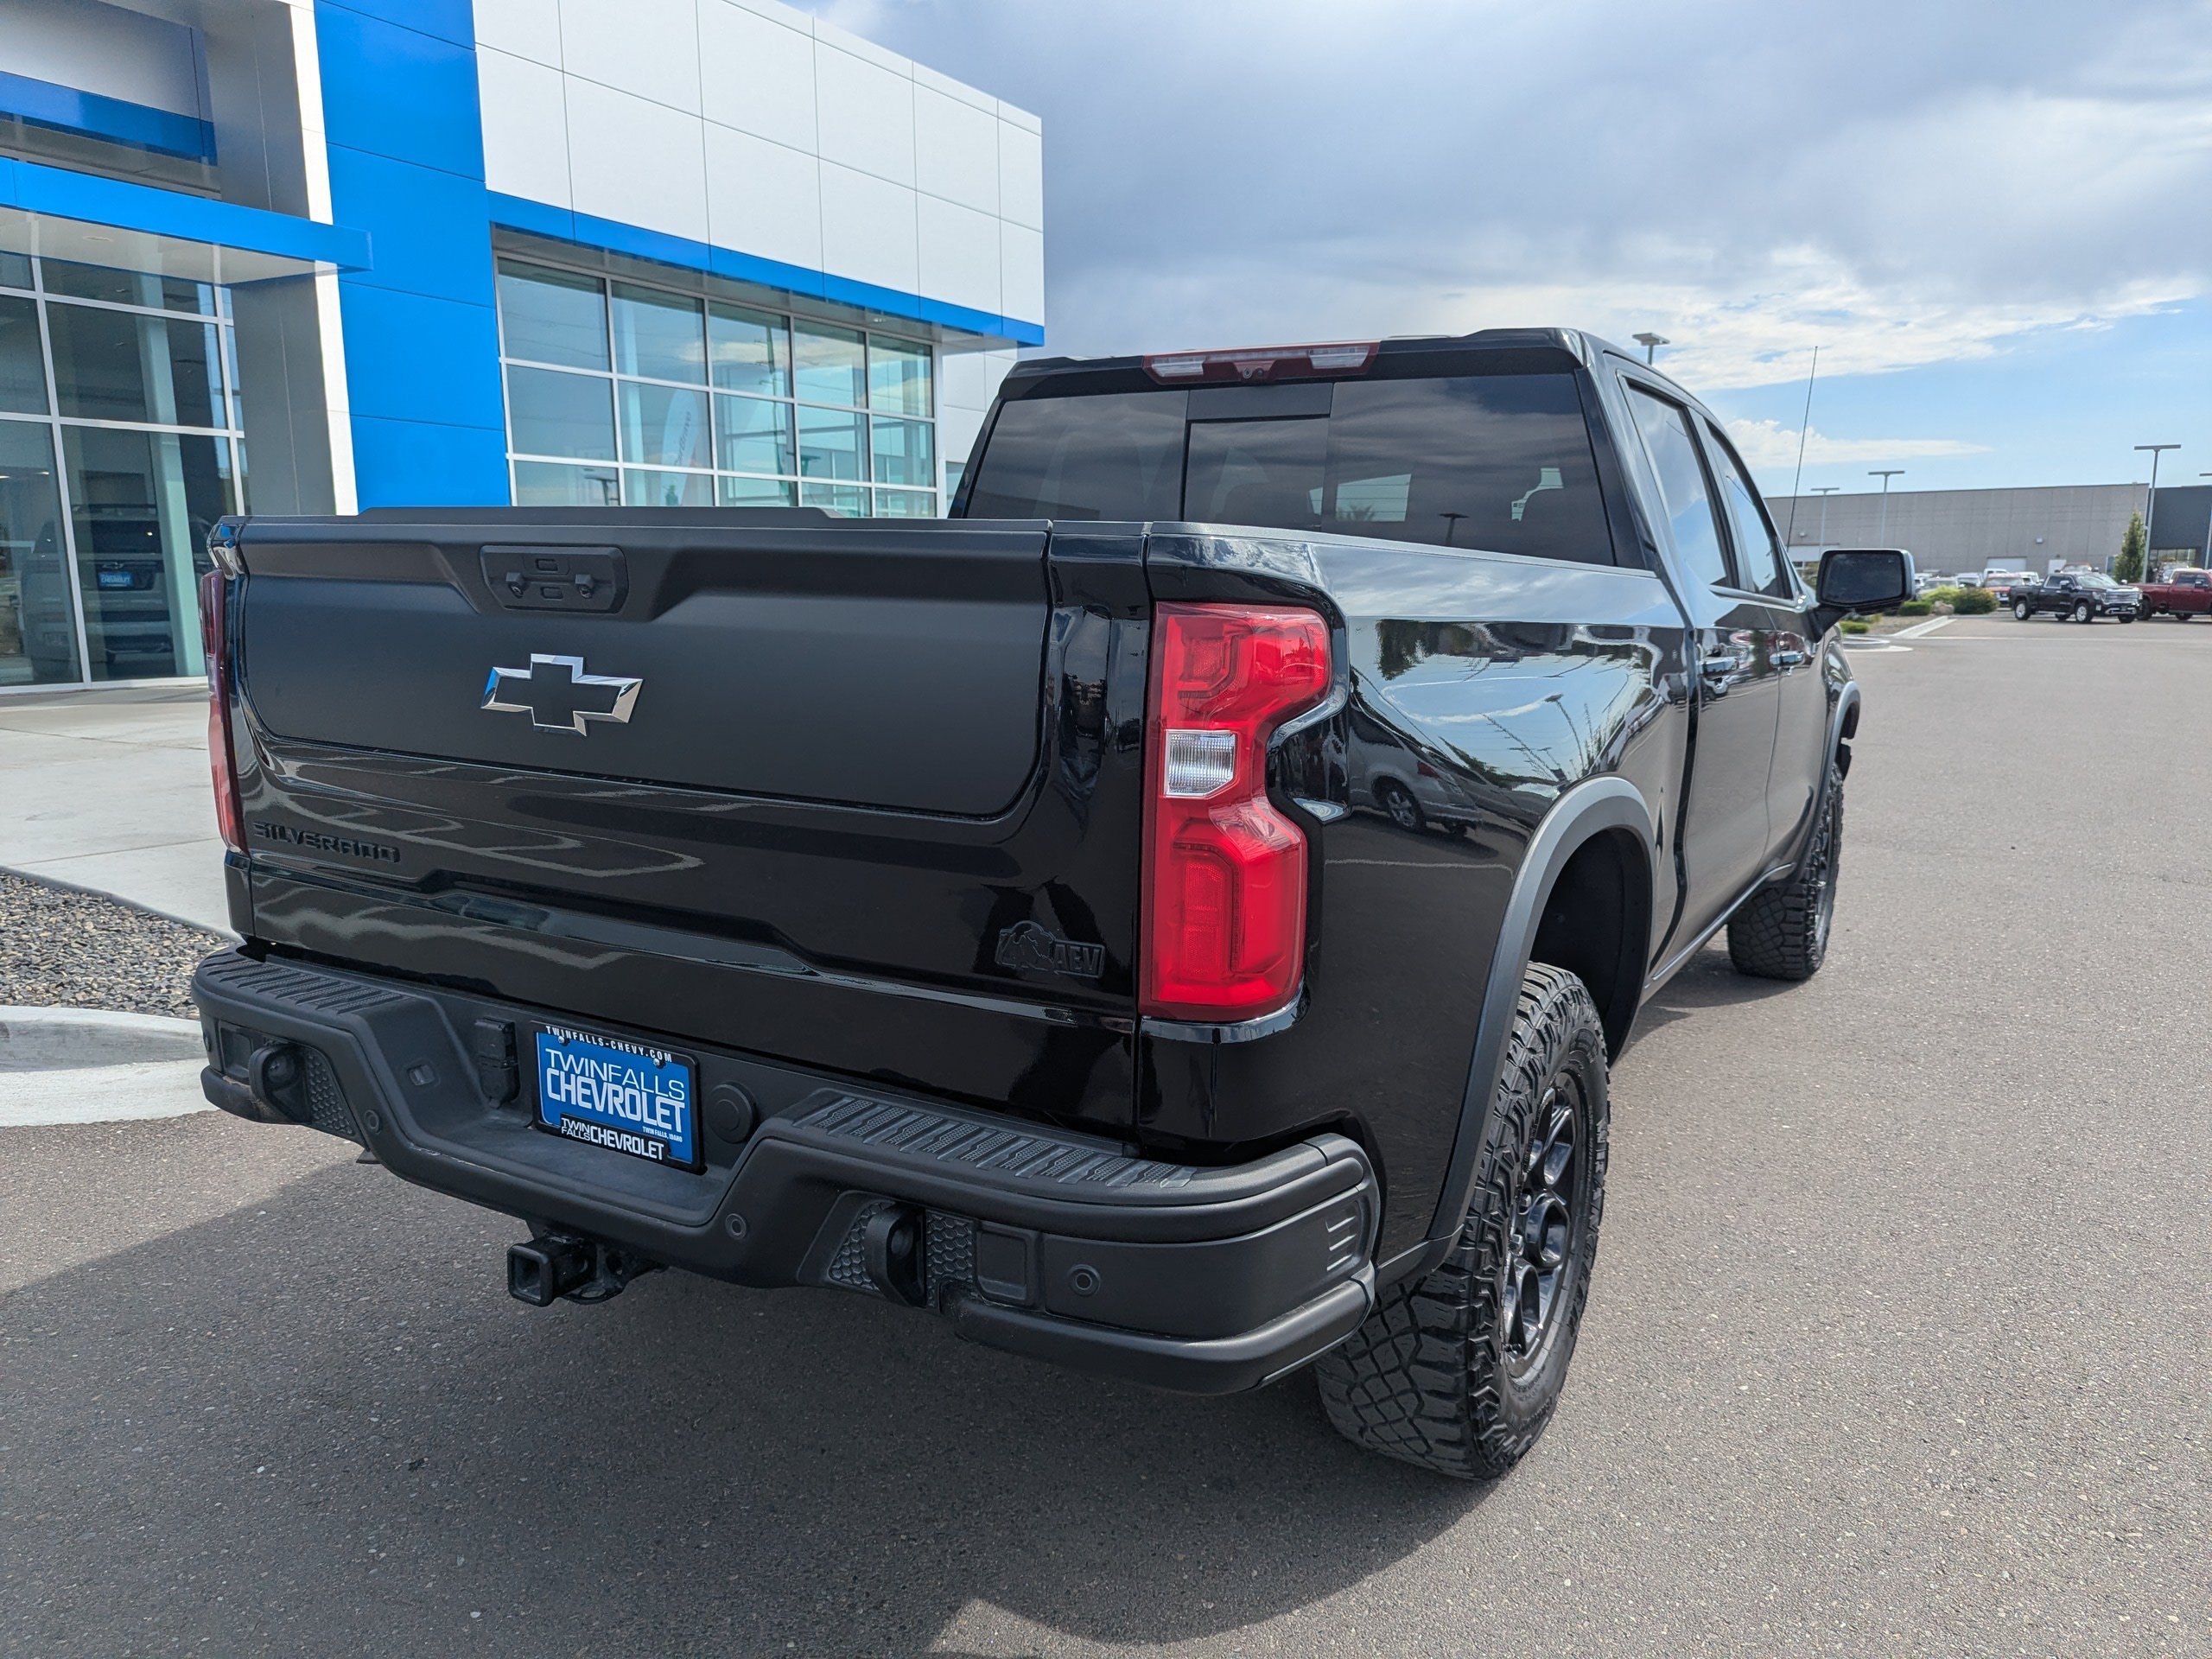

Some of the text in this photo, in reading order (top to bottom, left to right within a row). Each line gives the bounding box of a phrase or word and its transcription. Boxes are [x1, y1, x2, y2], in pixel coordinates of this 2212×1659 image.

[252, 820, 401, 863] SILVERADO
[1054, 944, 1100, 971] AEV
[545, 1025, 672, 1063] TWINFALLS-CHEVY.COM
[546, 1067, 685, 1133] CHEVROLET
[561, 1117, 591, 1133] TWIN
[561, 1126, 591, 1141] FALLS
[669, 1134, 683, 1142] IDAHO
[590, 1126, 664, 1160] CHEVROLET
